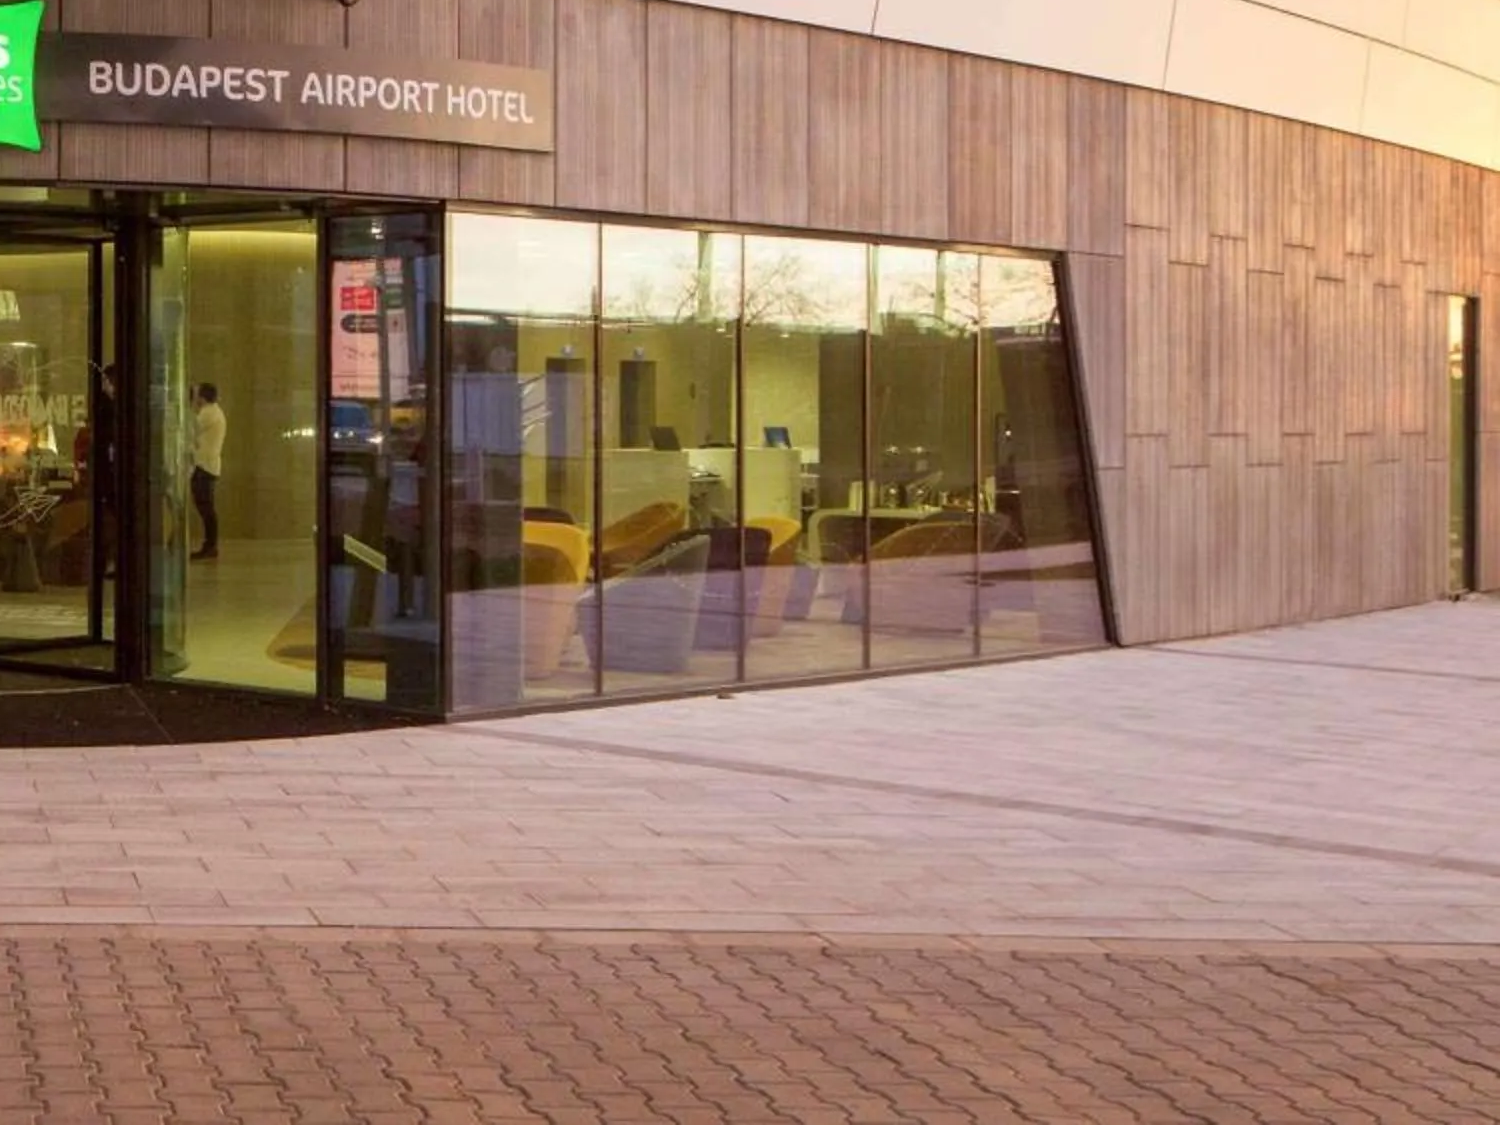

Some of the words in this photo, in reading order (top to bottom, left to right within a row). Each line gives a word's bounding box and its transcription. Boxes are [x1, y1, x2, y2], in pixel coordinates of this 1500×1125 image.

[88, 60, 290, 103] BUDAPEST
[300, 71, 440, 114] AIRPORT
[446, 83, 534, 124] HOTEL
